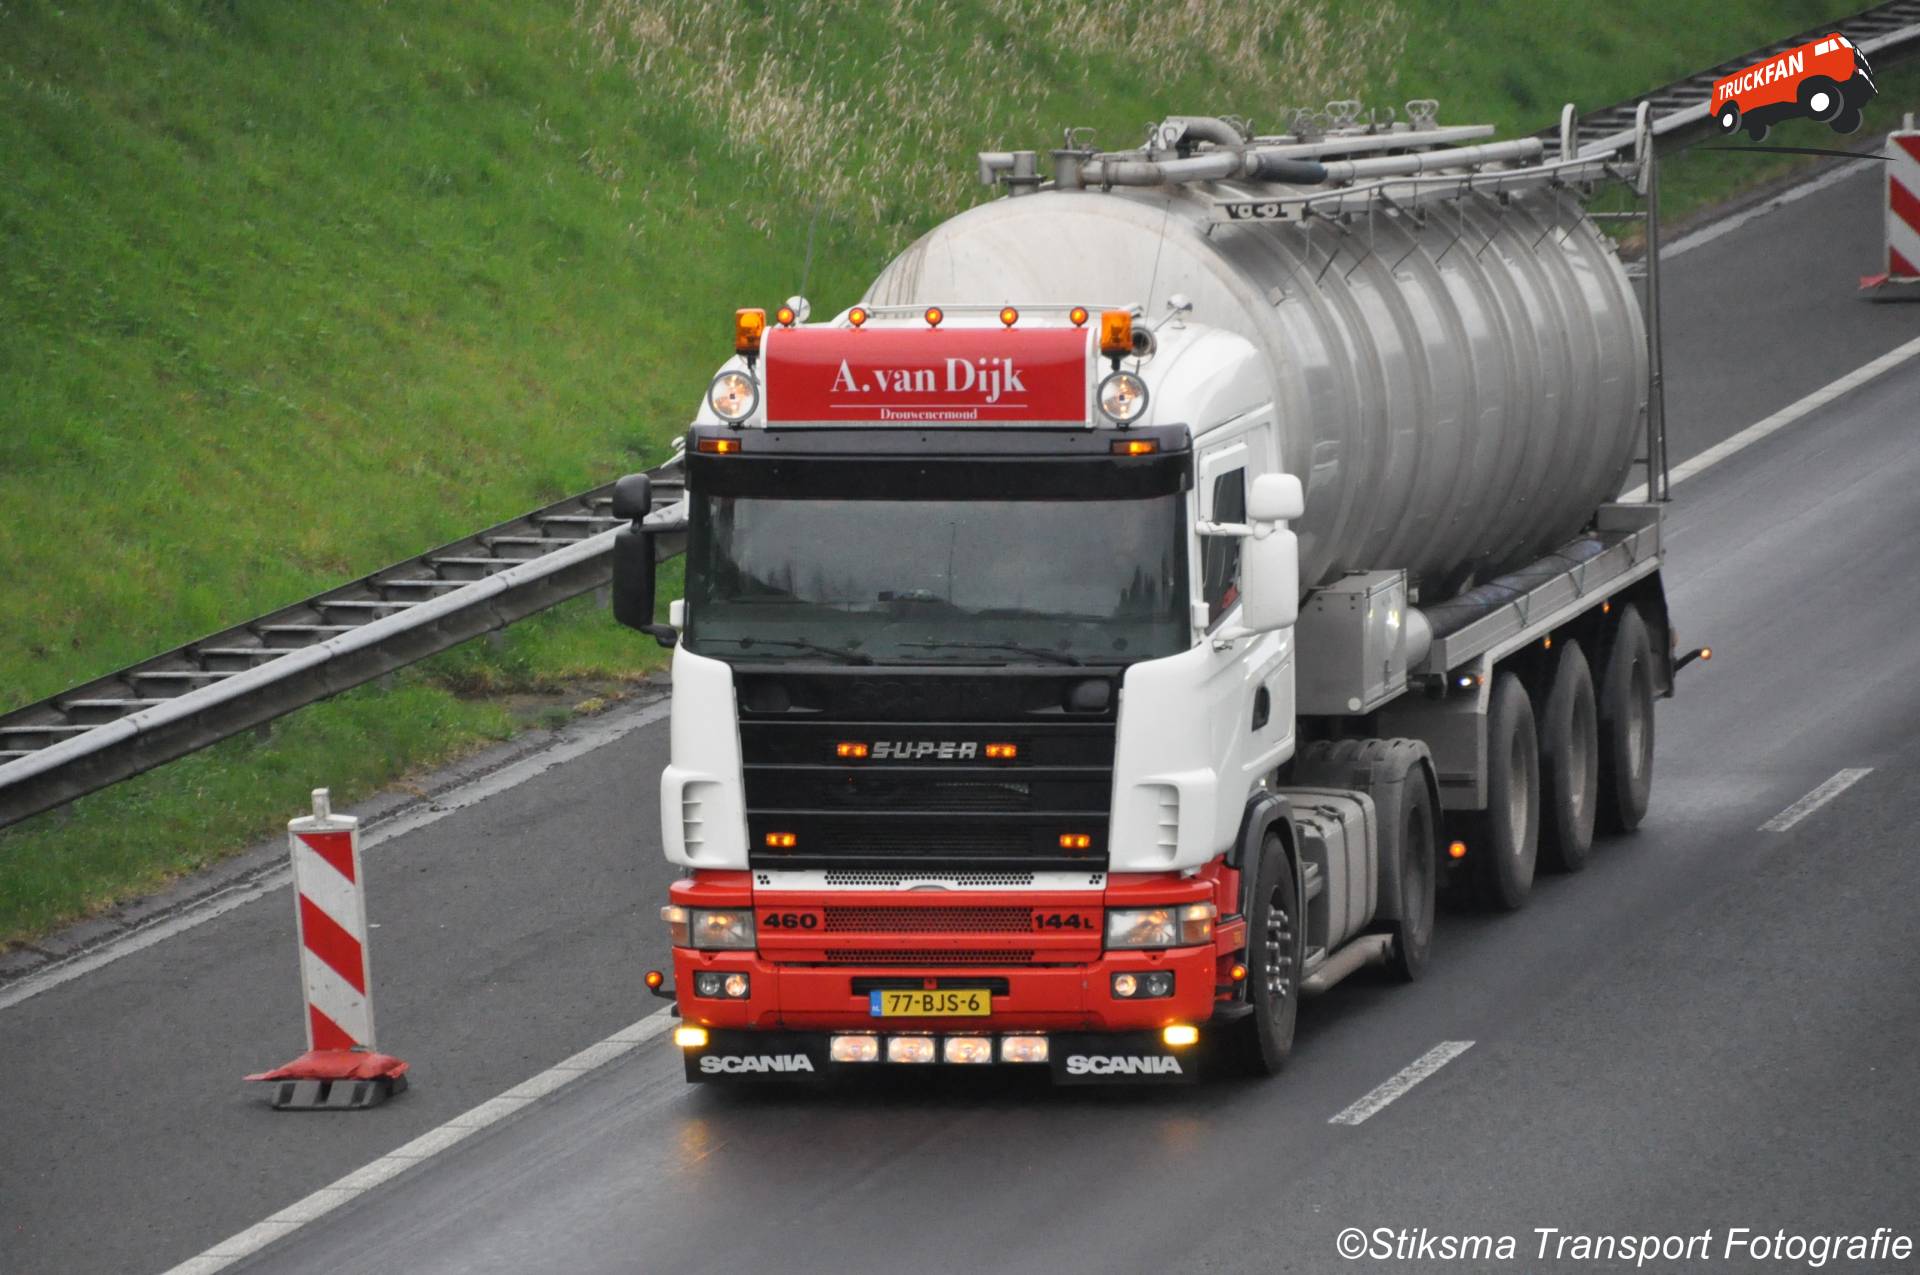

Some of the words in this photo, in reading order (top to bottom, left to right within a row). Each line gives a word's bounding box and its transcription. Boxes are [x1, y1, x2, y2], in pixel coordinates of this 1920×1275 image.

[944, 357, 1027, 403] Dijk
[880, 408, 978, 420] Drouwenermond
[872, 741, 978, 759] SUPER
[763, 912, 818, 929] 460
[889, 994, 980, 1012] 77-BJS-6
[700, 1053, 815, 1073] SCANIA
[1066, 1055, 1183, 1074] SCANIA
